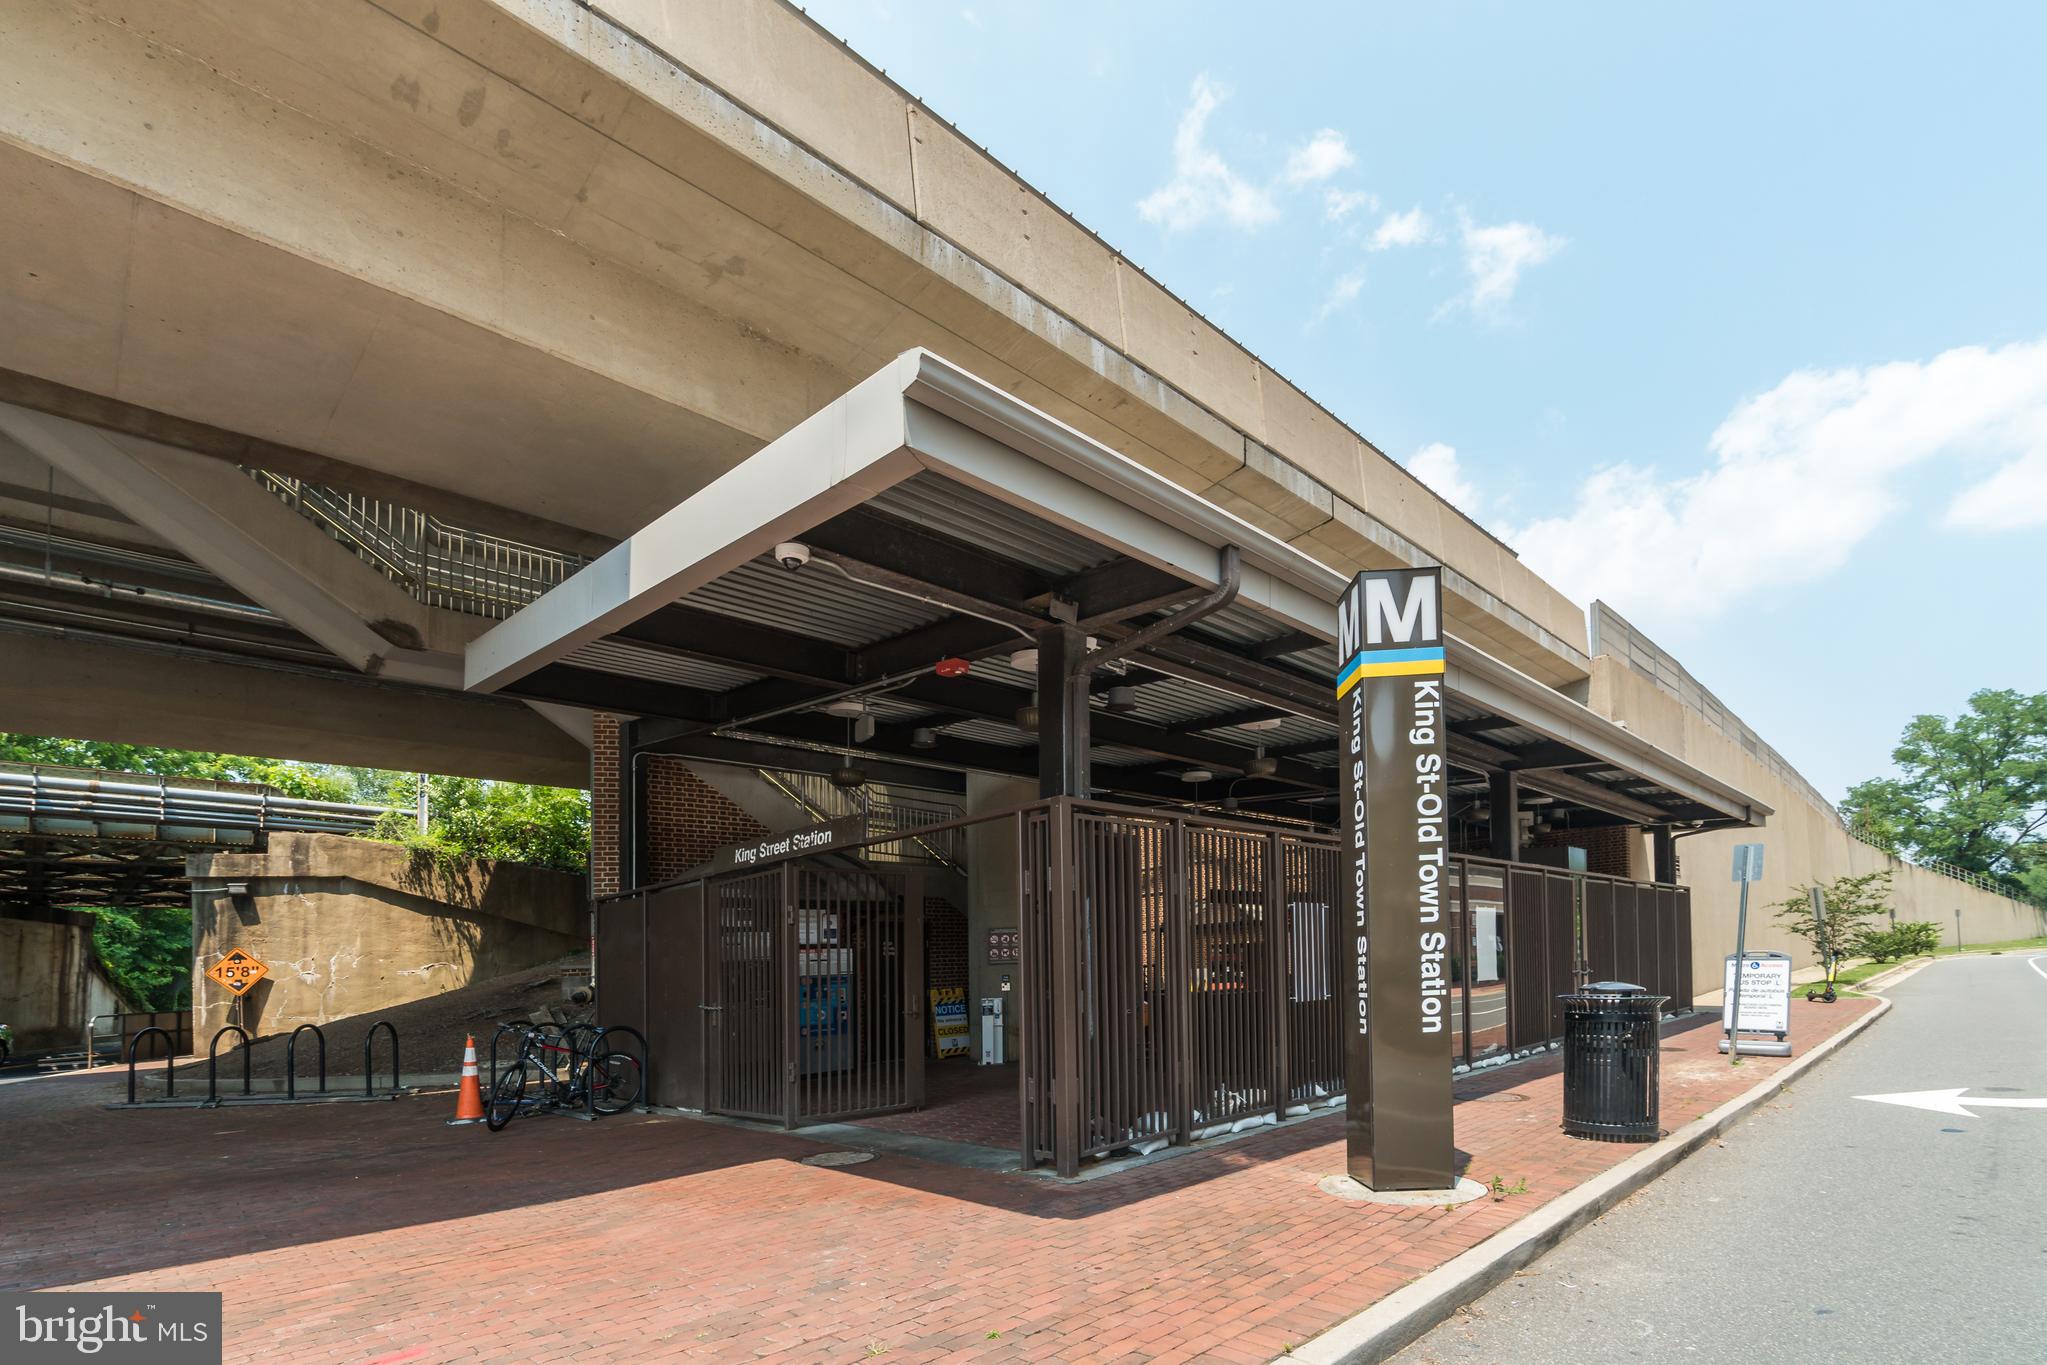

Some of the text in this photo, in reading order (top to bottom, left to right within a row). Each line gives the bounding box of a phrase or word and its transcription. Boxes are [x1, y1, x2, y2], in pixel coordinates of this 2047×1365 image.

[1338, 583, 1360, 668] M
[1365, 575, 1437, 644] M
[735, 830, 832, 863] King Street Station
[1350, 687, 1368, 1035] King St-Old Town Station
[1409, 681, 1446, 1033] King St-Old Town Station
[215, 966, 259, 978] 15'8"
[935, 1004, 967, 1015] NOTICE
[937, 1026, 969, 1036] CLOSED
